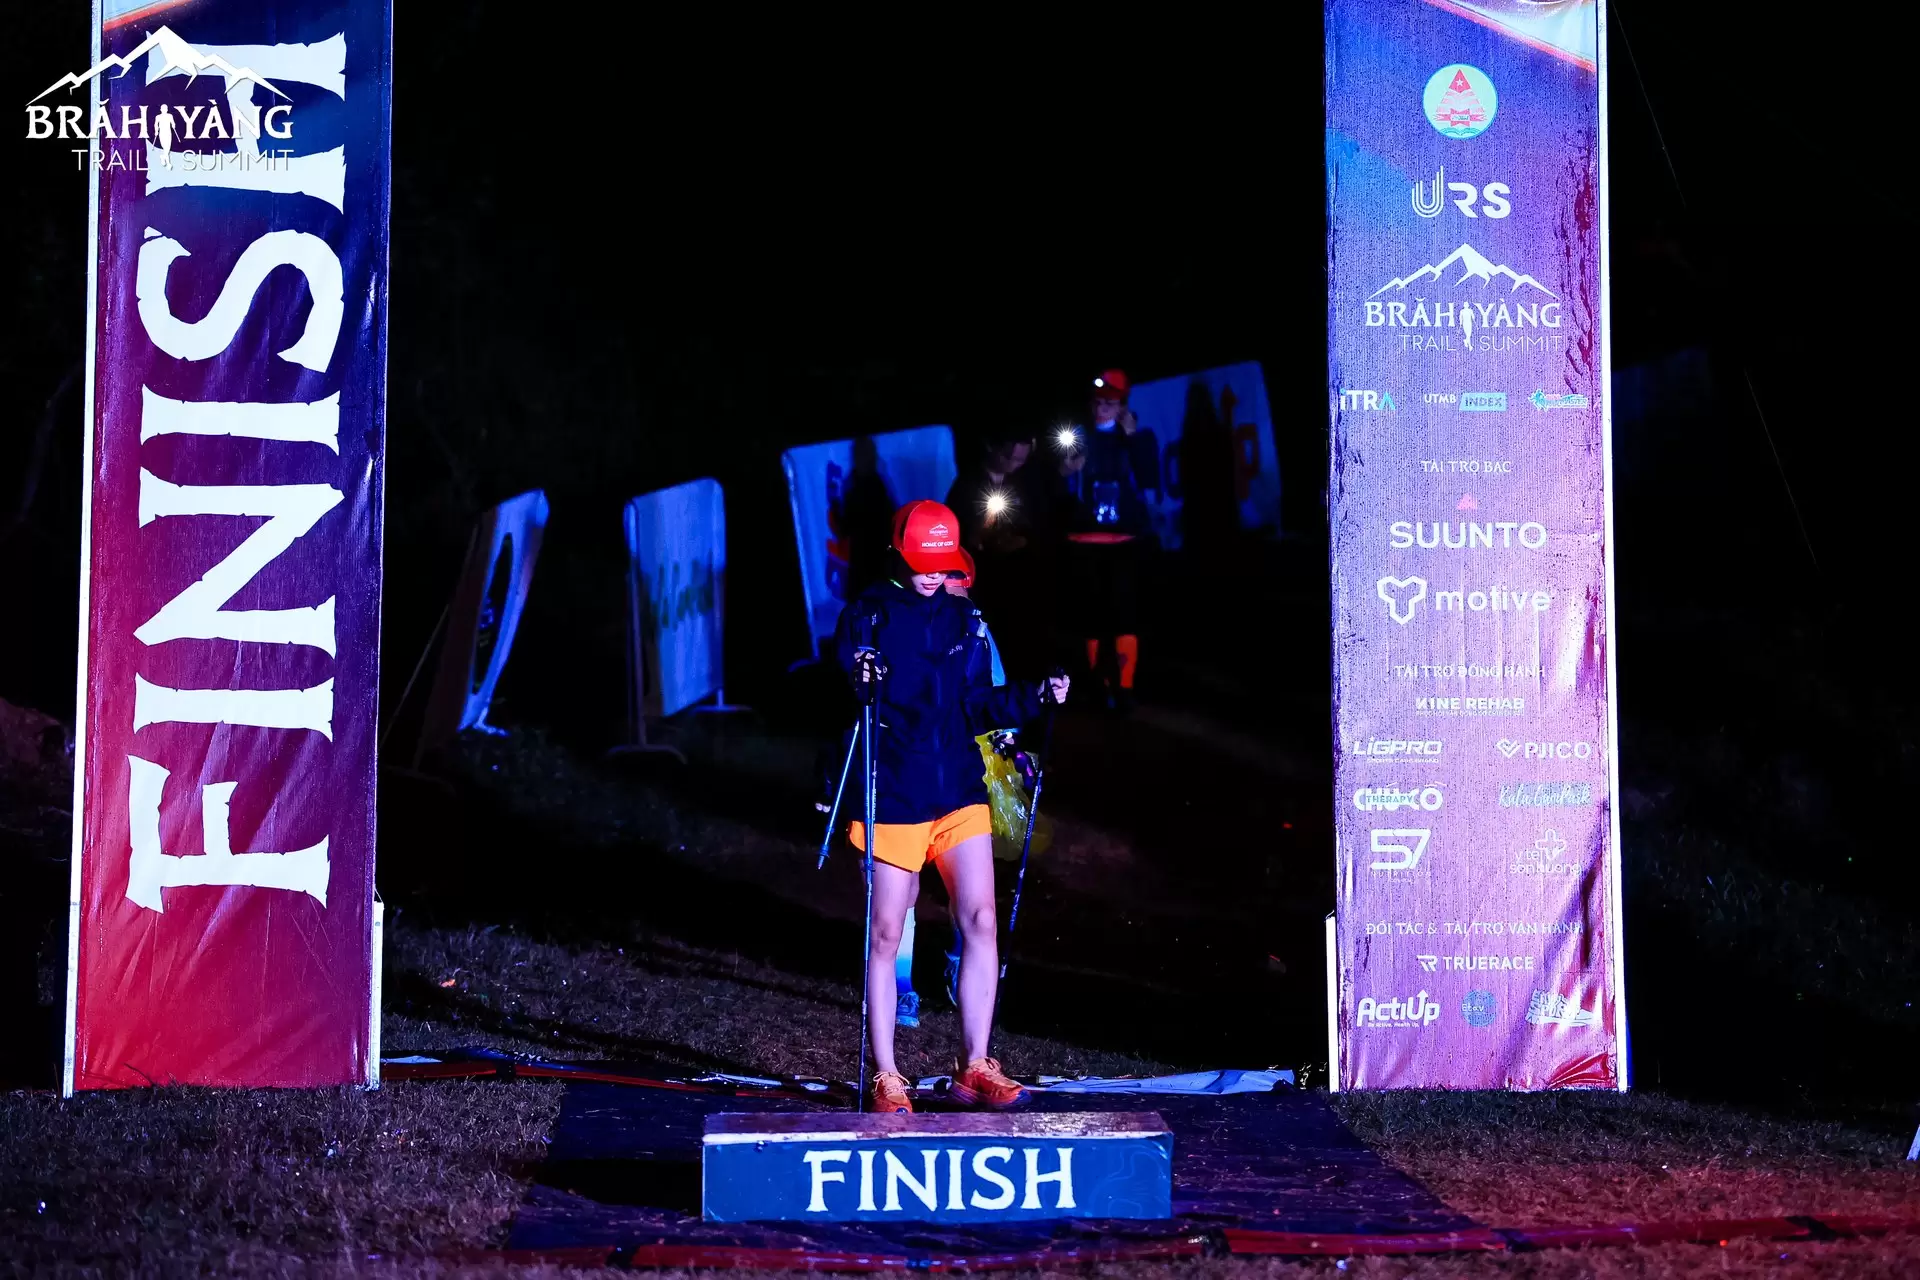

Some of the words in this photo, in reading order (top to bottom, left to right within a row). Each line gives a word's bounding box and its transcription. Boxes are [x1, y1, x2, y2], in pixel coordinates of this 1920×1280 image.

[1411, 166, 1511, 219] URS
[1398, 334, 1457, 352] TRAIL
[1479, 334, 1562, 352] SUMMIT
[1424, 394, 1456, 404] UTMB
[1465, 396, 1502, 408] INDEX
[125, 31, 347, 914] FINISH
[1389, 520, 1547, 549] SUUNTO
[1435, 587, 1550, 611] motive
[1465, 697, 1524, 709] REHAB
[1525, 742, 1591, 759] PJICO
[1366, 795, 1414, 803] THERAPY
[1427, 922, 1438, 935] &
[1443, 956, 1534, 970] TRUERACE
[803, 1147, 1076, 1213] FINISH
